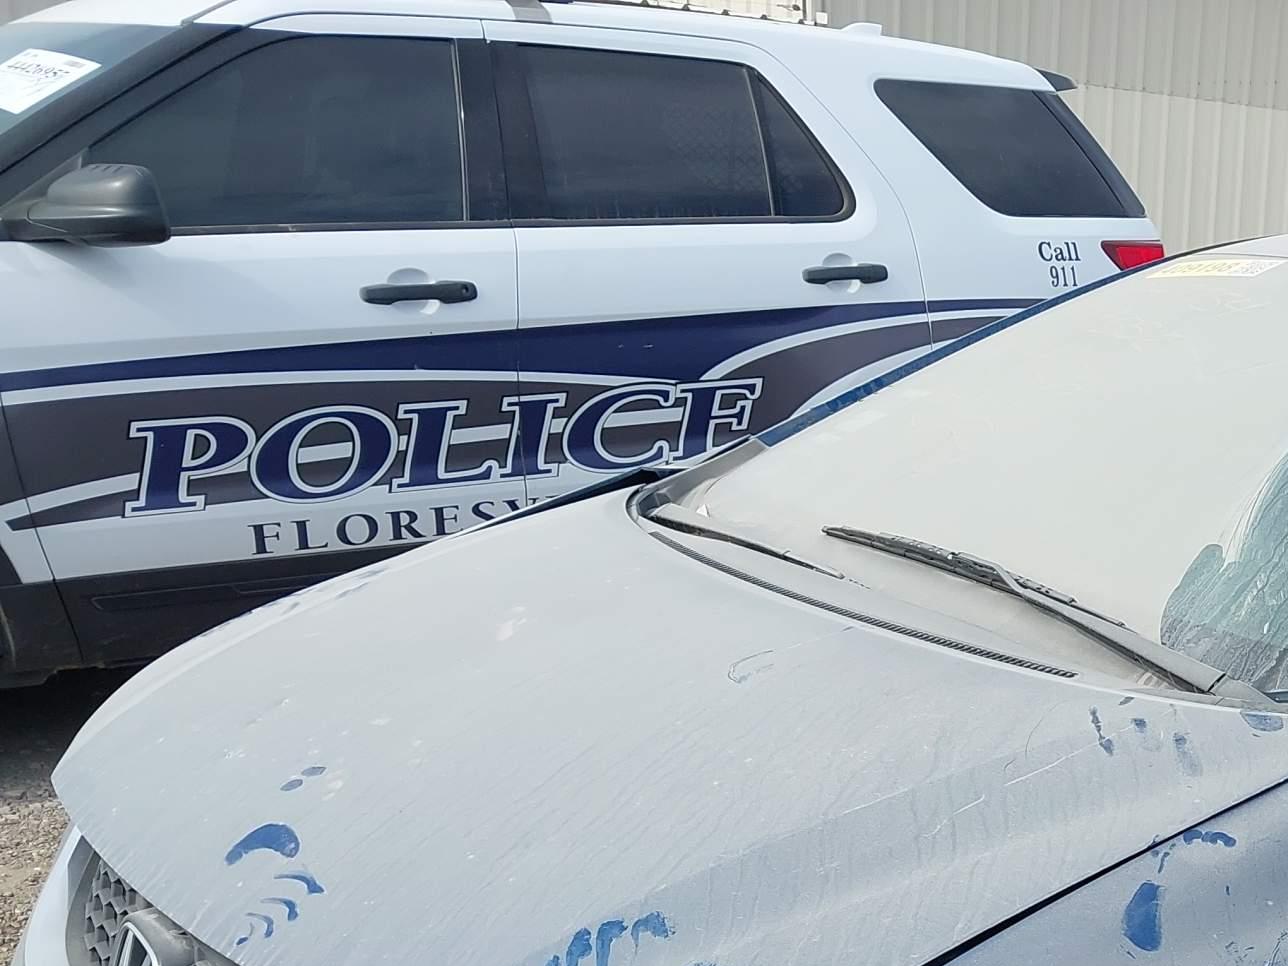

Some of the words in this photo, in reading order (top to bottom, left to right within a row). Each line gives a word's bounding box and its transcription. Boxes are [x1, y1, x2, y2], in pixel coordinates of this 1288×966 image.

[1038, 241, 1081, 262] Call
[1049, 265, 1079, 288] 911
[122, 378, 765, 517] POLICE
